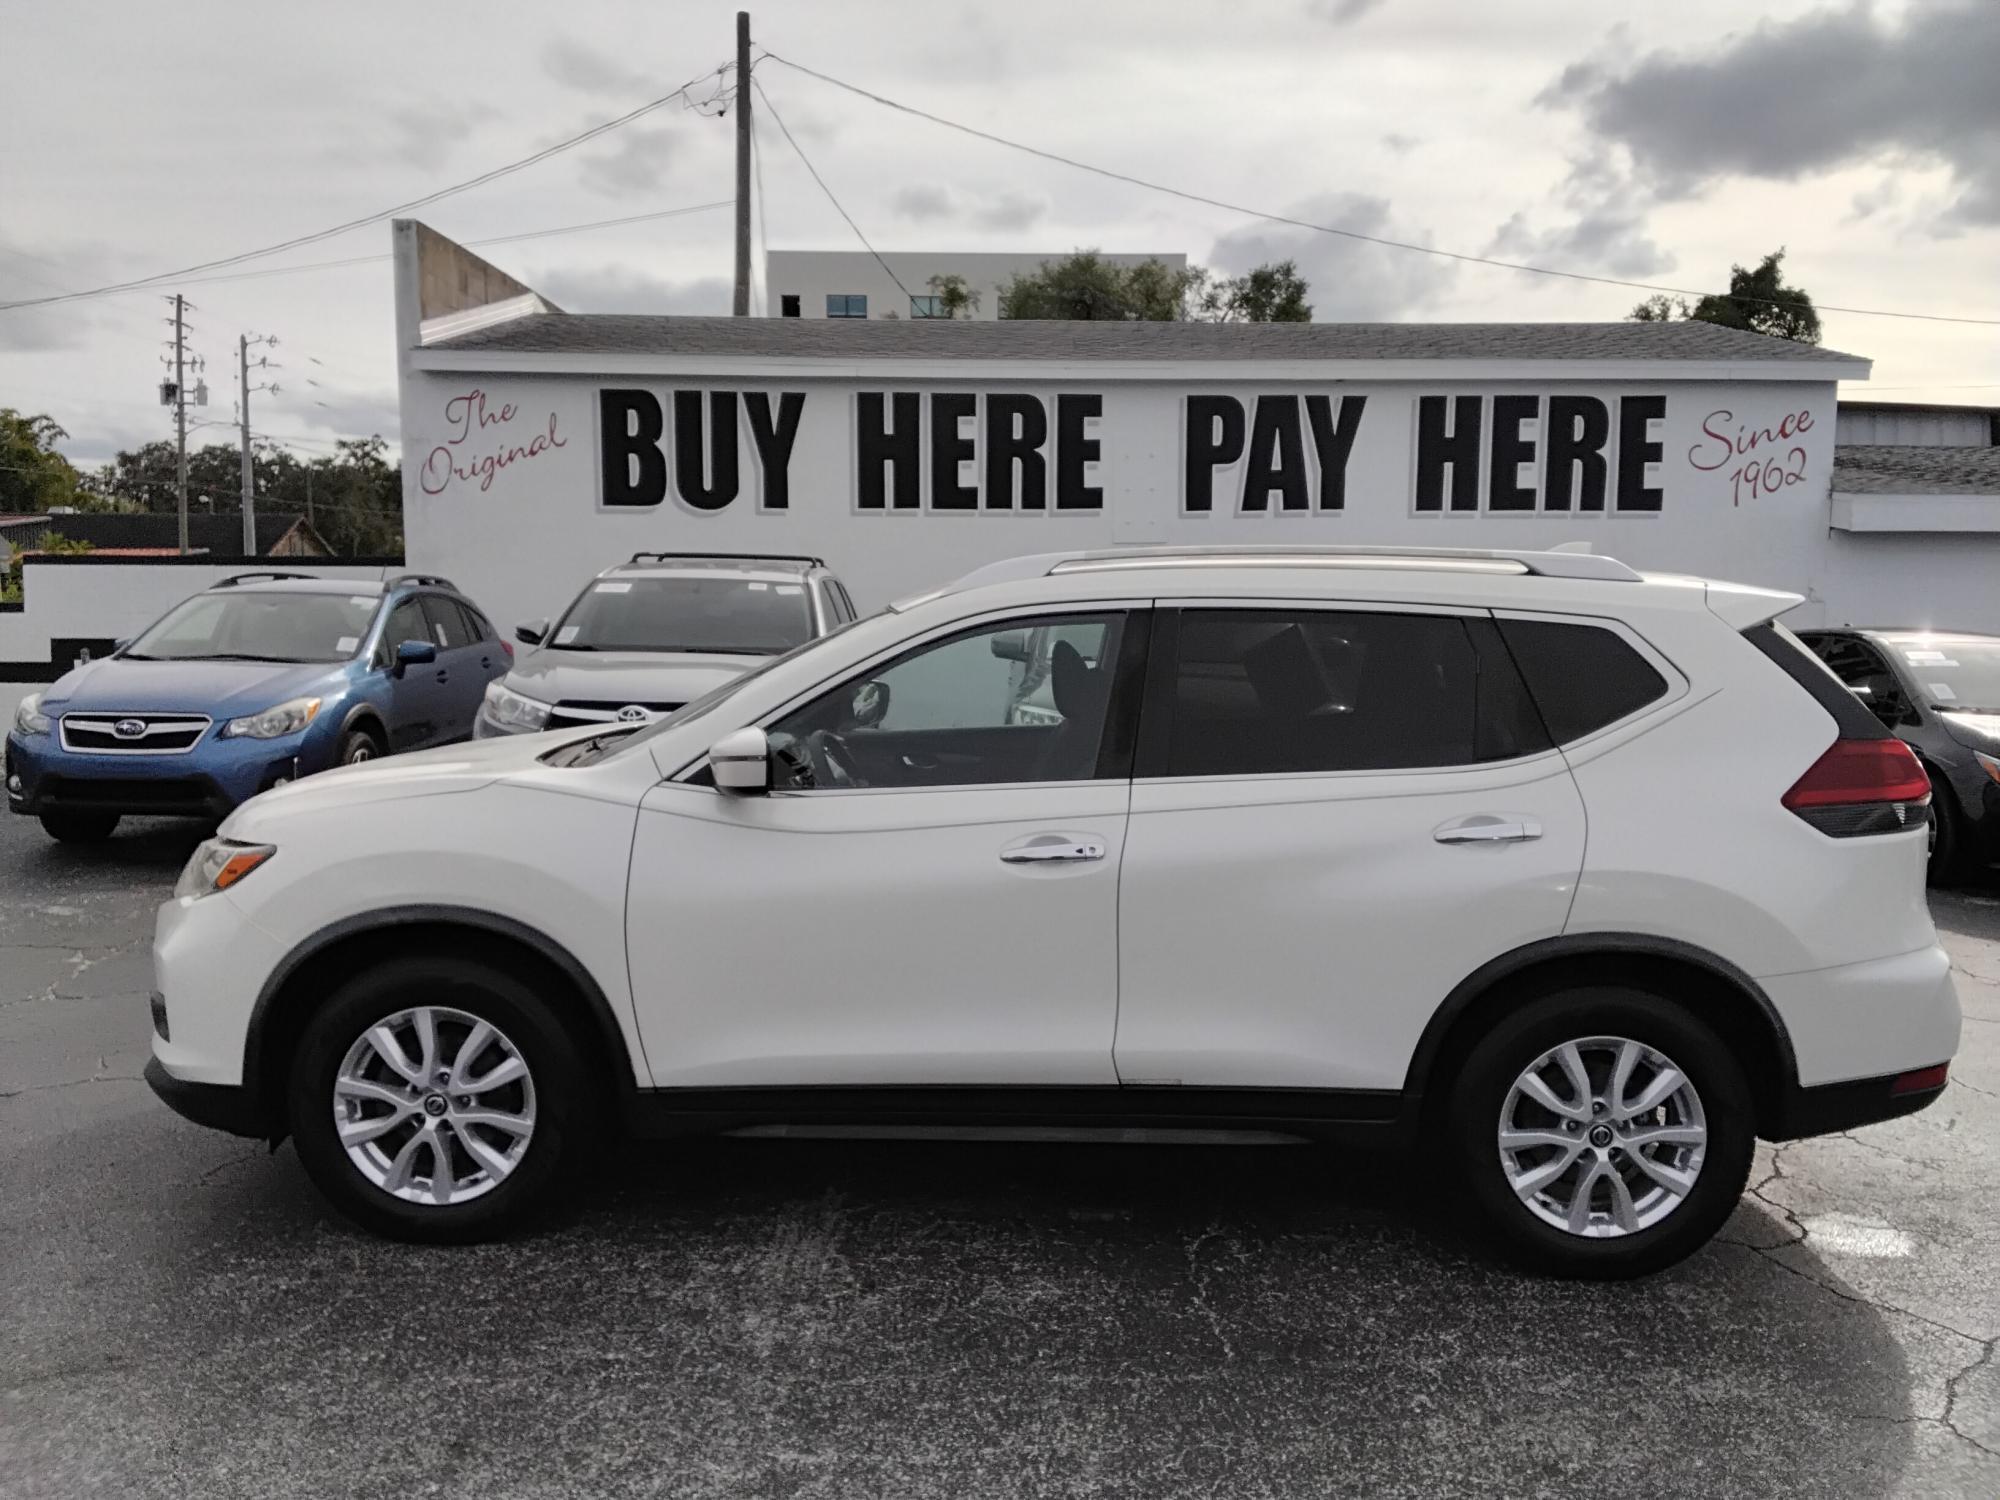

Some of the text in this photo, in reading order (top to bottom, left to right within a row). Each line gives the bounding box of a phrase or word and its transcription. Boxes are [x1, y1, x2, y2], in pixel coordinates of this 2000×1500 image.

[445, 389, 518, 444] The
[1688, 409, 1815, 470] Since
[420, 413, 567, 495] Original
[599, 388, 1667, 512] BUY HERE PAY HERE
[1729, 447, 1807, 508] 1962
